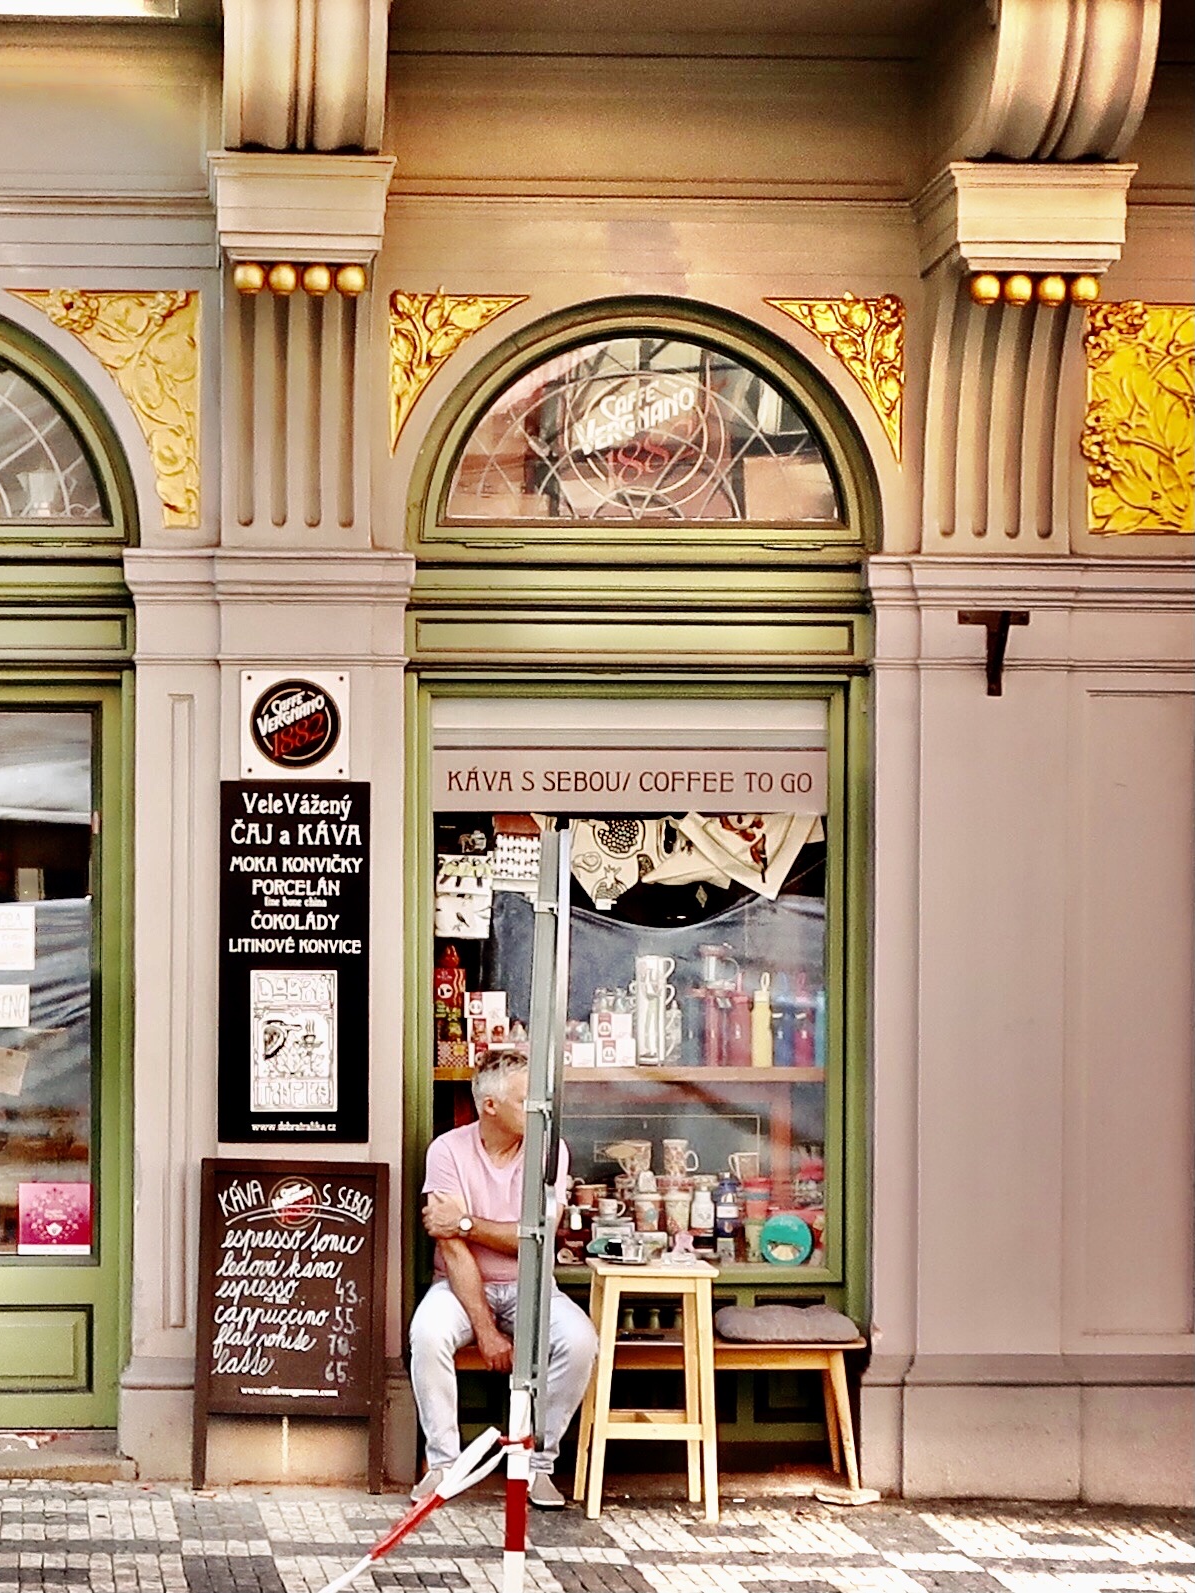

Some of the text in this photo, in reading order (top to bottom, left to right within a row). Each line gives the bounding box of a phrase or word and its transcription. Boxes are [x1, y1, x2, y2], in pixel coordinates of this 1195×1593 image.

[574, 387, 695, 455] VERGNANO
[256, 694, 325, 737] VERGNANO
[272, 713, 325, 757] 1882
[447, 766, 513, 791] KÁVA
[521, 771, 535, 791] S
[639, 771, 734, 792] COFFEE
[744, 772, 773, 793] TO
[781, 772, 813, 793] GO
[230, 818, 362, 846] ČAJ a KÁVA
[229, 854, 363, 873] MOKA KONVIČKY
[252, 877, 340, 896] PORCELÁN
[251, 910, 340, 931] ČOKOLÁDY
[229, 936, 362, 954] LITINOVÉ KONVICE
[218, 1179, 265, 1217] KÁVA
[321, 1184, 332, 1206] S
[221, 1229, 306, 1258] espresso
[215, 1279, 299, 1305] espresso
[214, 1305, 330, 1331] cappuccino
